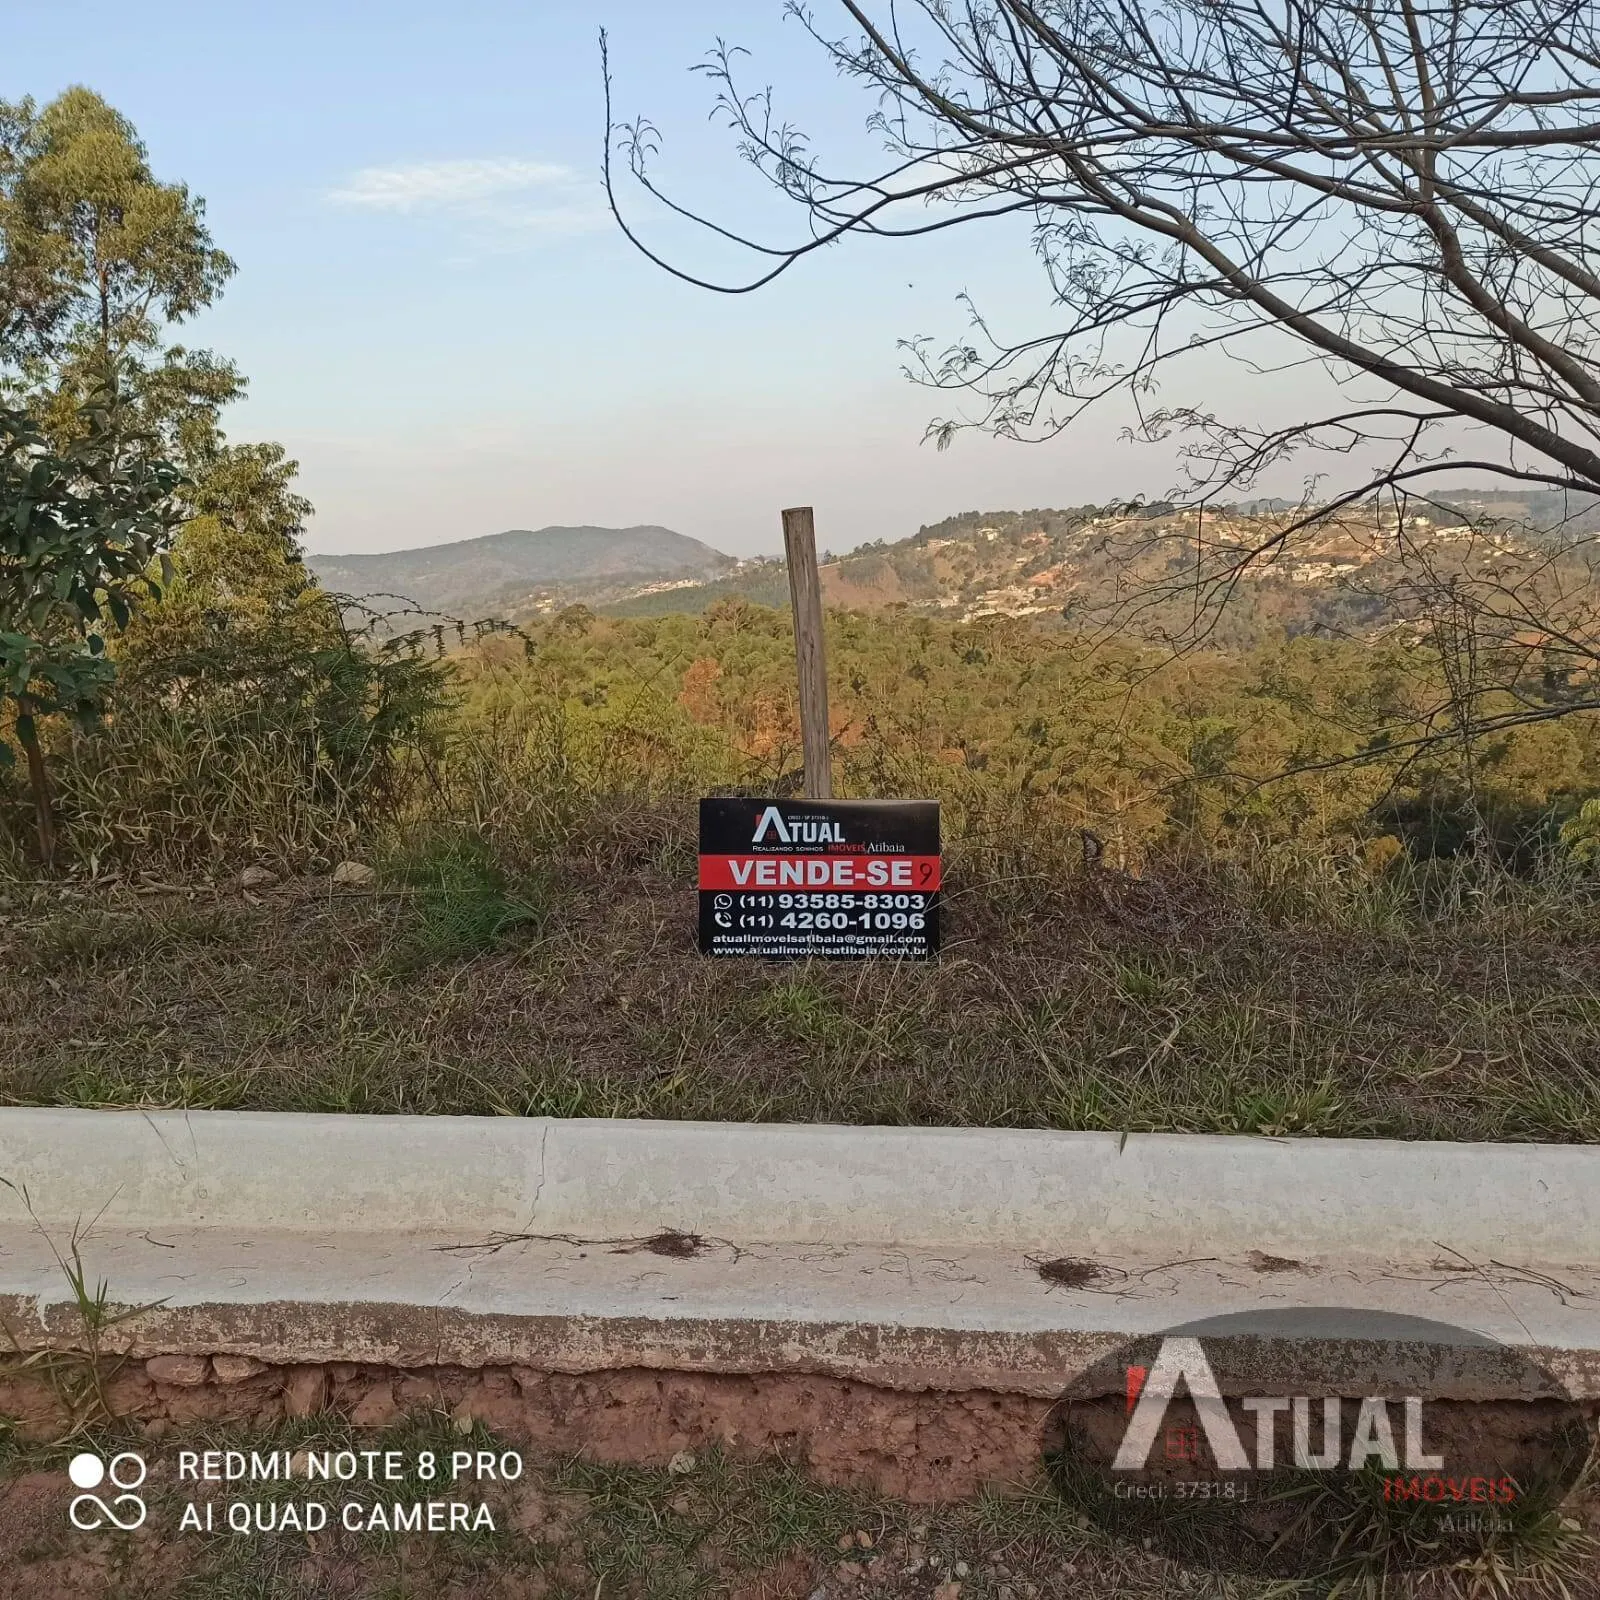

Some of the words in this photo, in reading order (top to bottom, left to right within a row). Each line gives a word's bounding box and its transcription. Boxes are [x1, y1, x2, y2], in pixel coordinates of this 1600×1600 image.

[752, 806, 845, 842] ATUAL
[728, 860, 912, 885] VENDE-SE
[919, 863, 933, 885] 9
[739, 895, 774, 909] (11)
[779, 894, 925, 909] 93585-8303
[739, 915, 774, 928] (11)
[780, 912, 926, 929] 4260-1096
